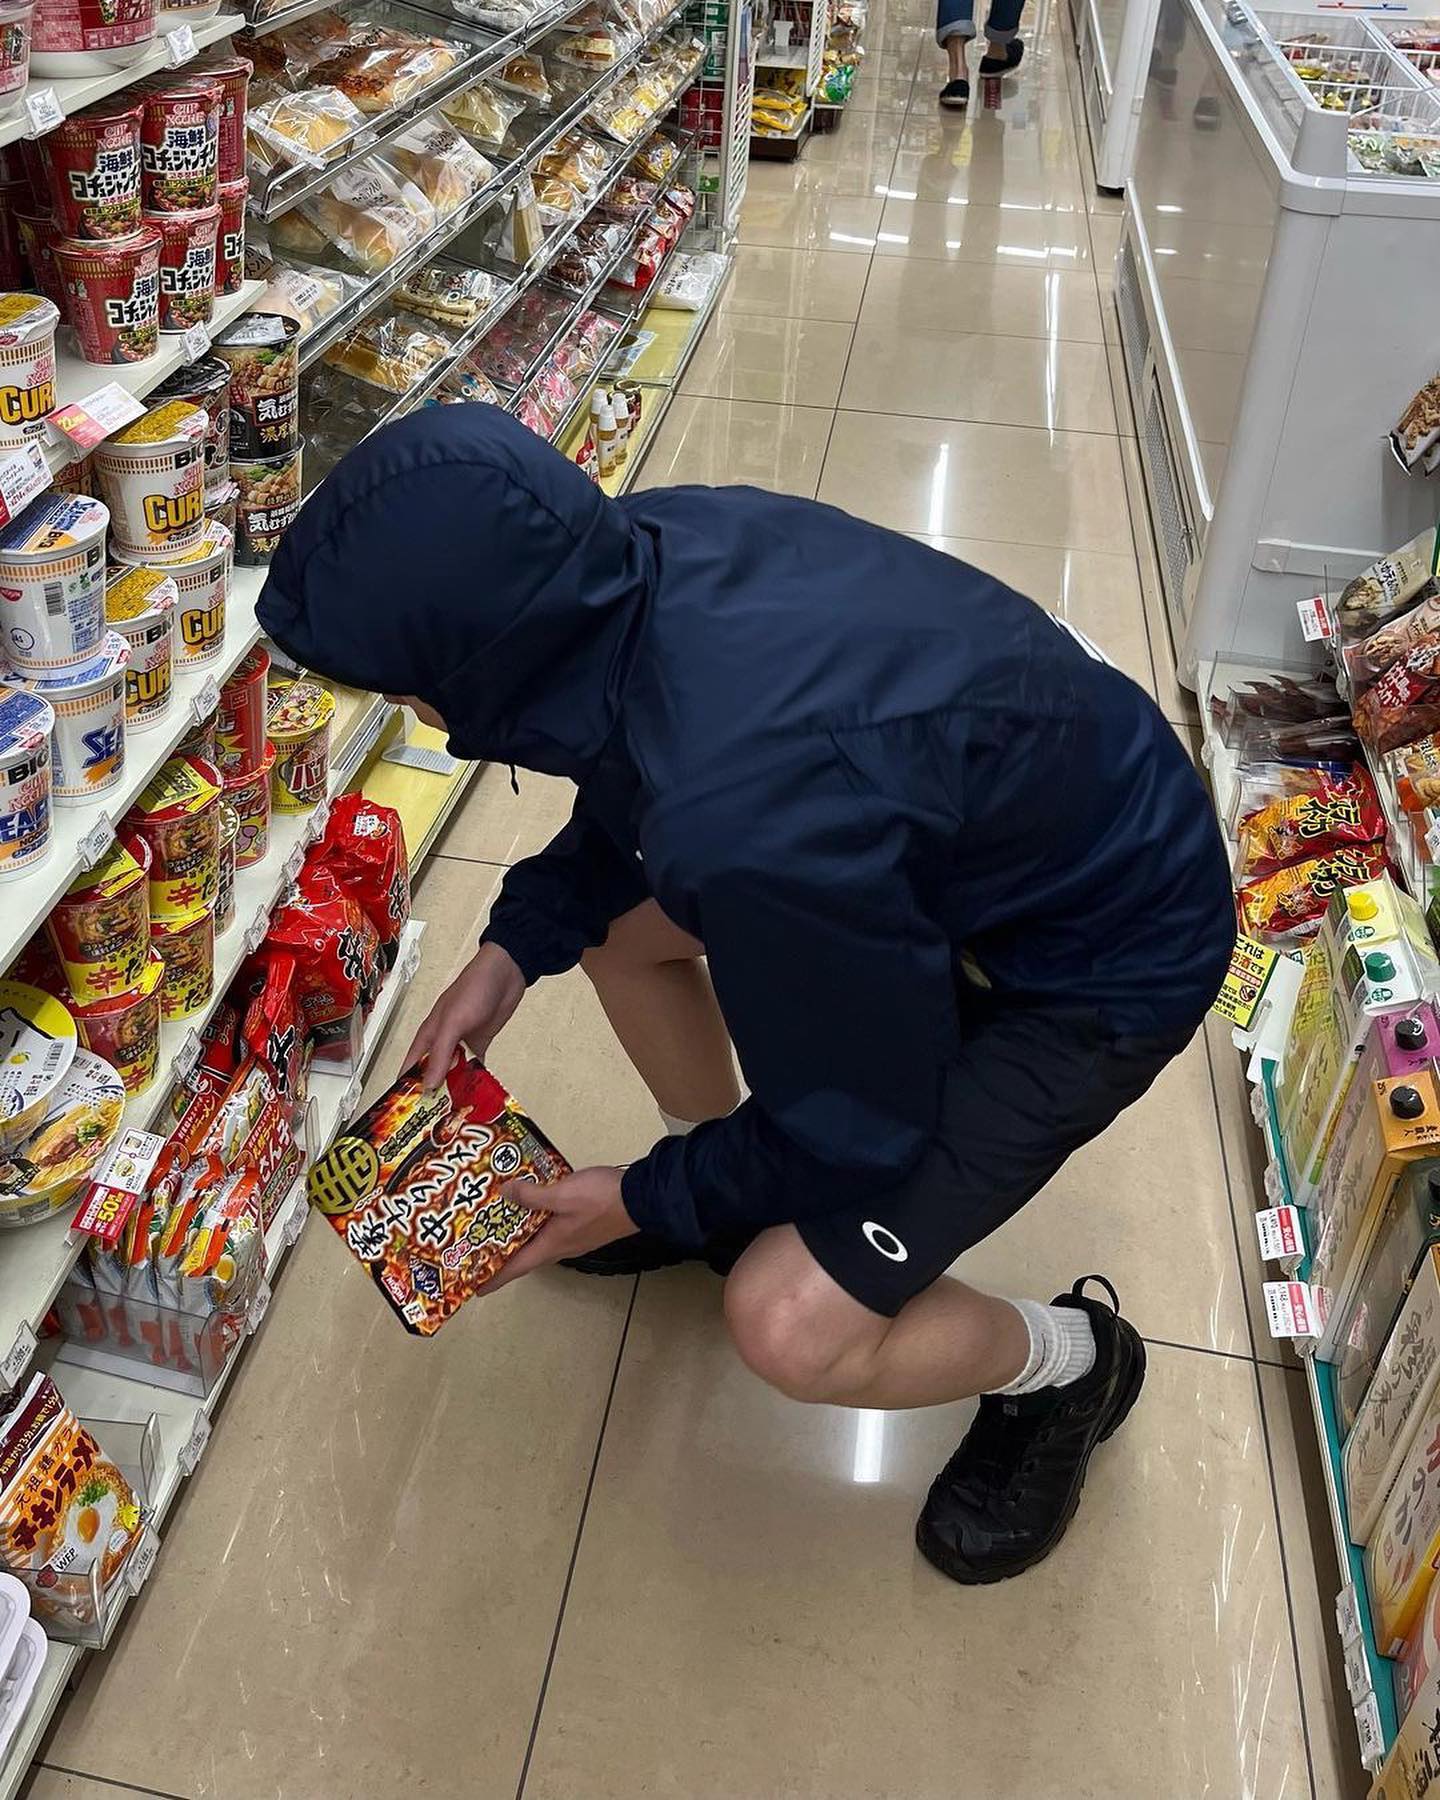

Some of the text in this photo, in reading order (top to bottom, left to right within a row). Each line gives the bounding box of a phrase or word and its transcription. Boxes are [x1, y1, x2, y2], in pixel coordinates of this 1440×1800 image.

[1234, 937, 1265, 961] これは
[350, 1127, 491, 1259] 蒙古タンメン
[420, 1174, 490, 1246] 中本
[55, 1547, 77, 1572] WFP
